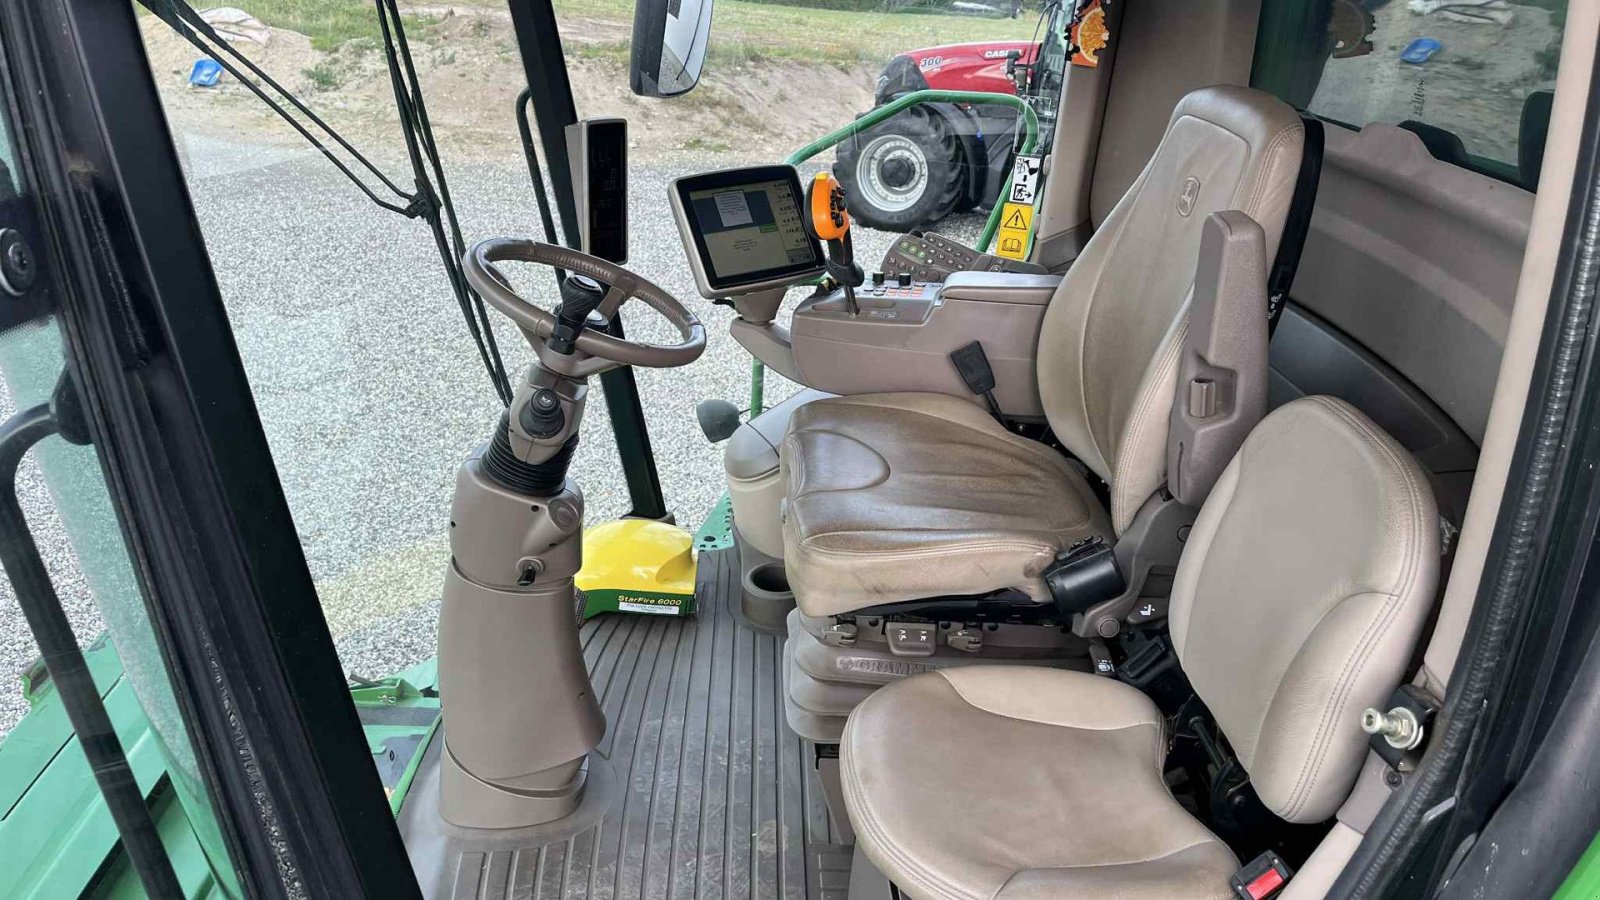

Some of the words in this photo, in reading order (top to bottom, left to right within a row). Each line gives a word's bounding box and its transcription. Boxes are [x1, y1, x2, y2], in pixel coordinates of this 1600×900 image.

[920, 56, 942, 67] 300
[618, 595, 655, 604] StarFire
[657, 598, 682, 606] 6000
